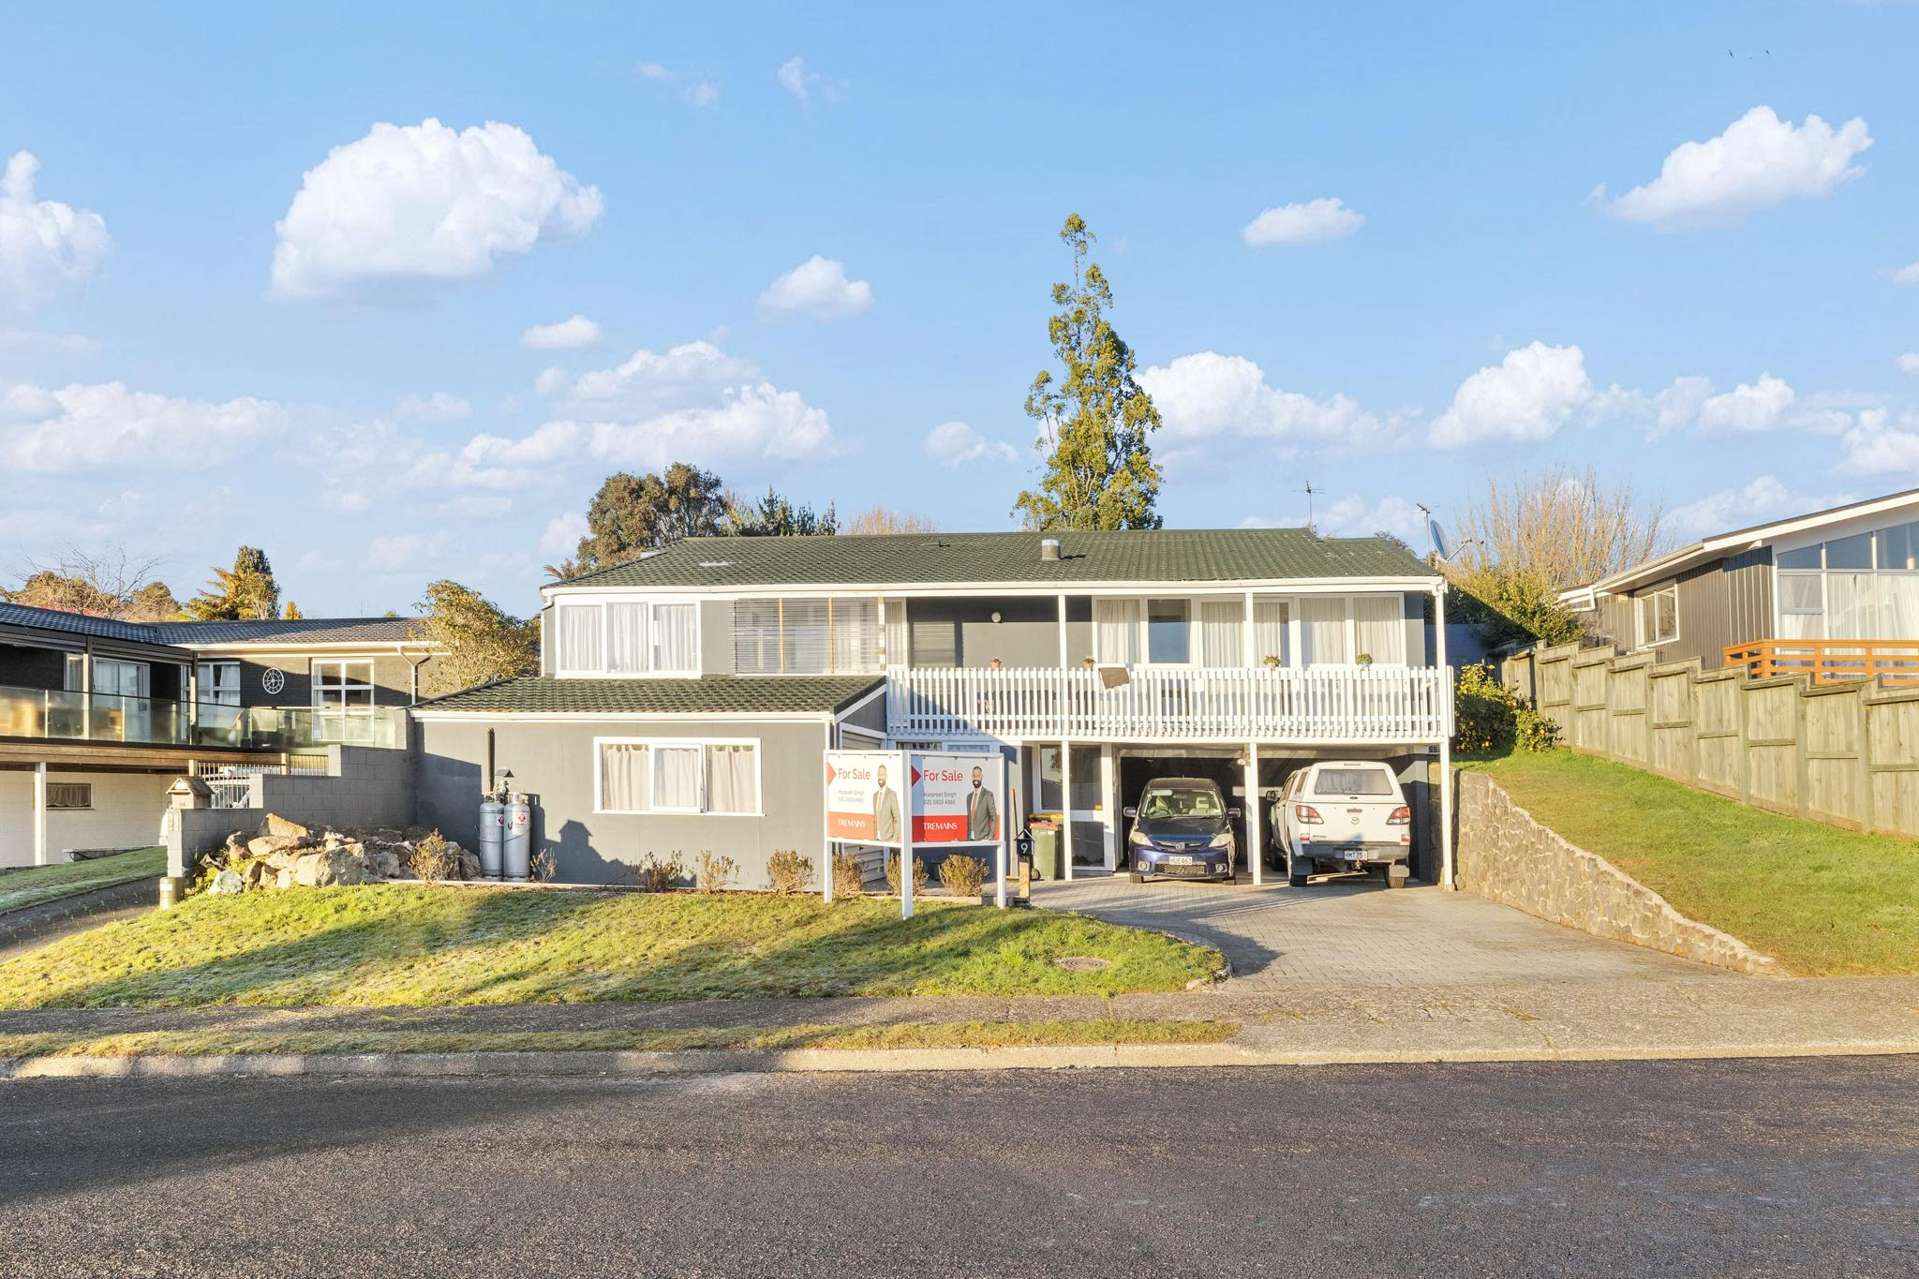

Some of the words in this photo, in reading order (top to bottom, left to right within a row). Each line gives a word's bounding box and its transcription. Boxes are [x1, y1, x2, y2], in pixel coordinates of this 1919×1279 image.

[838, 768, 851, 780] For
[852, 768, 871, 780] Sale
[923, 769, 940, 781] For
[941, 770, 964, 782] Sale
[922, 822, 959, 831] TREMAINS
[1020, 842, 1029, 854] 9
